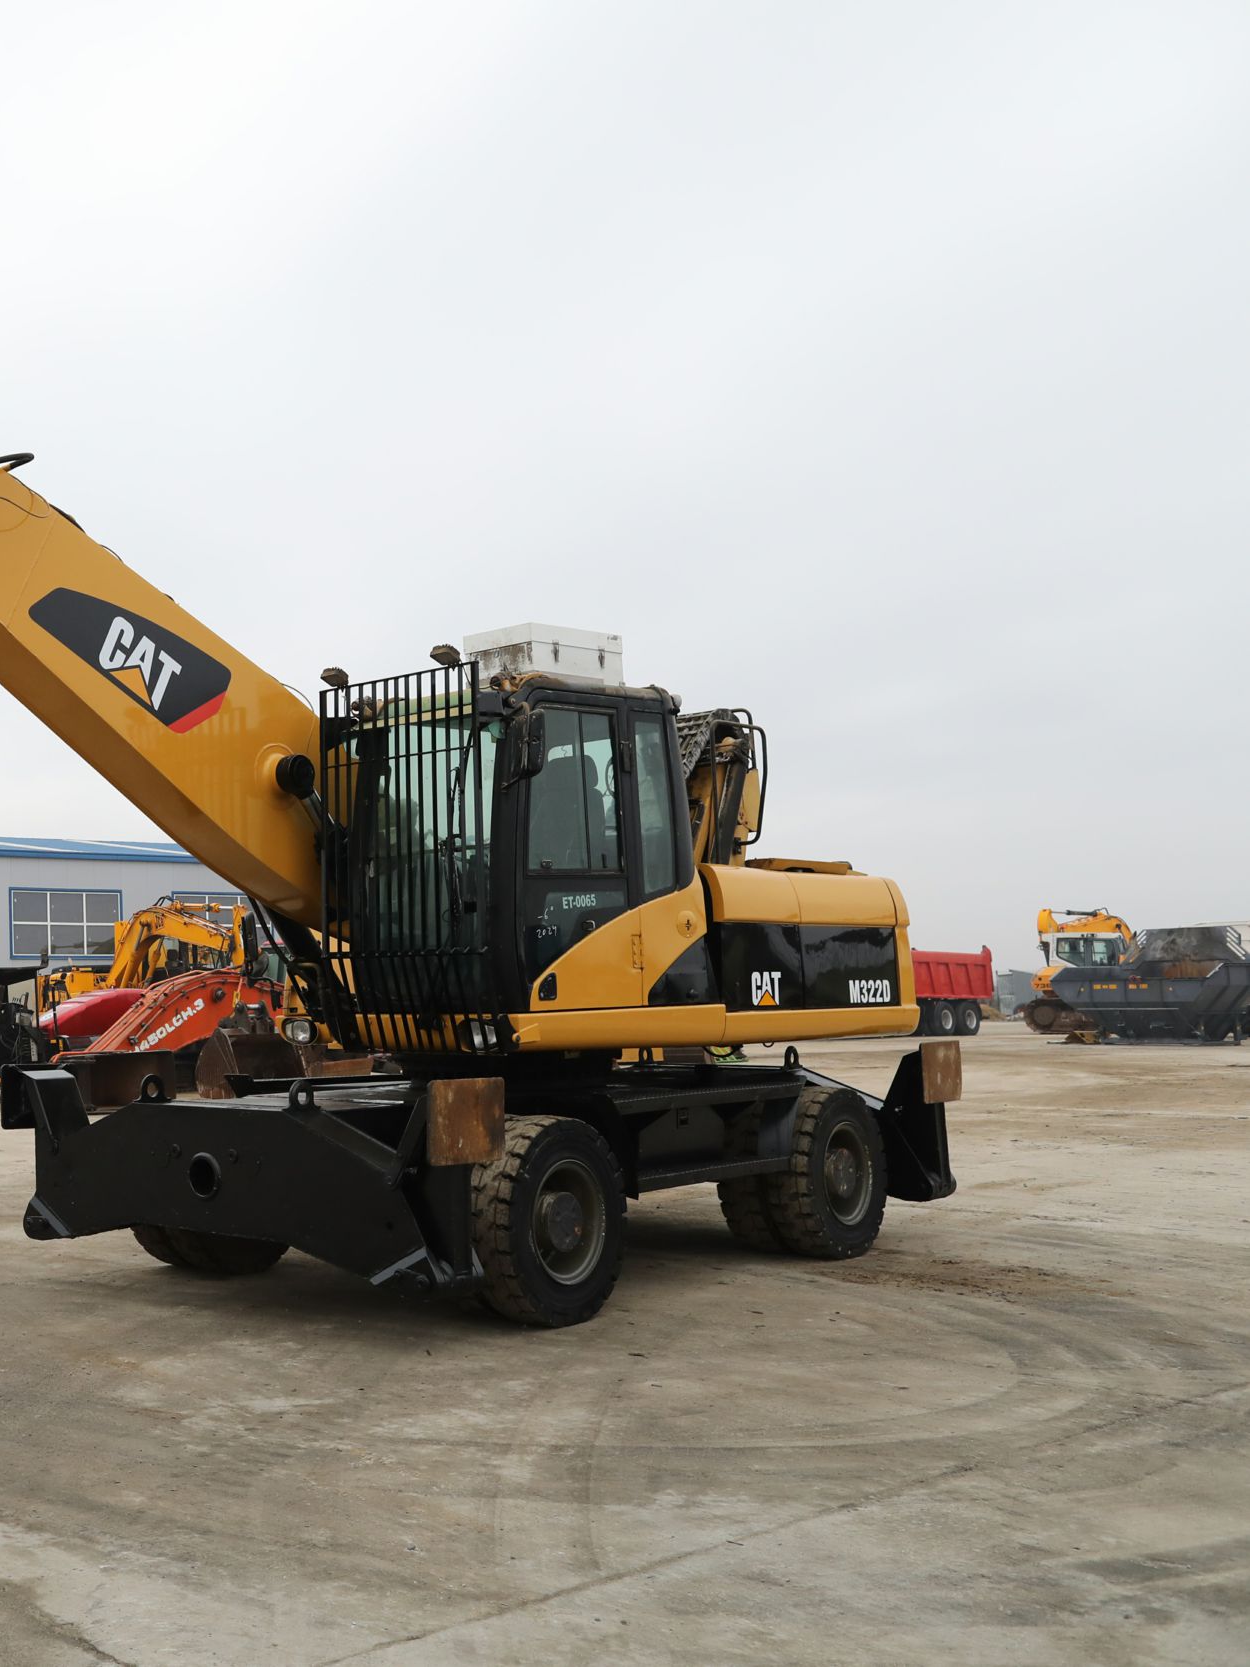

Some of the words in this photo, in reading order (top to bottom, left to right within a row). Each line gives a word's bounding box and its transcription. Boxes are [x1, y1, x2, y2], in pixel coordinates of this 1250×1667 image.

[99, 616, 183, 711] CAT
[562, 894, 596, 909] ET-0065
[536, 925, 557, 939] 2024
[751, 971, 781, 1006] CAT
[849, 979, 891, 1004] M322D
